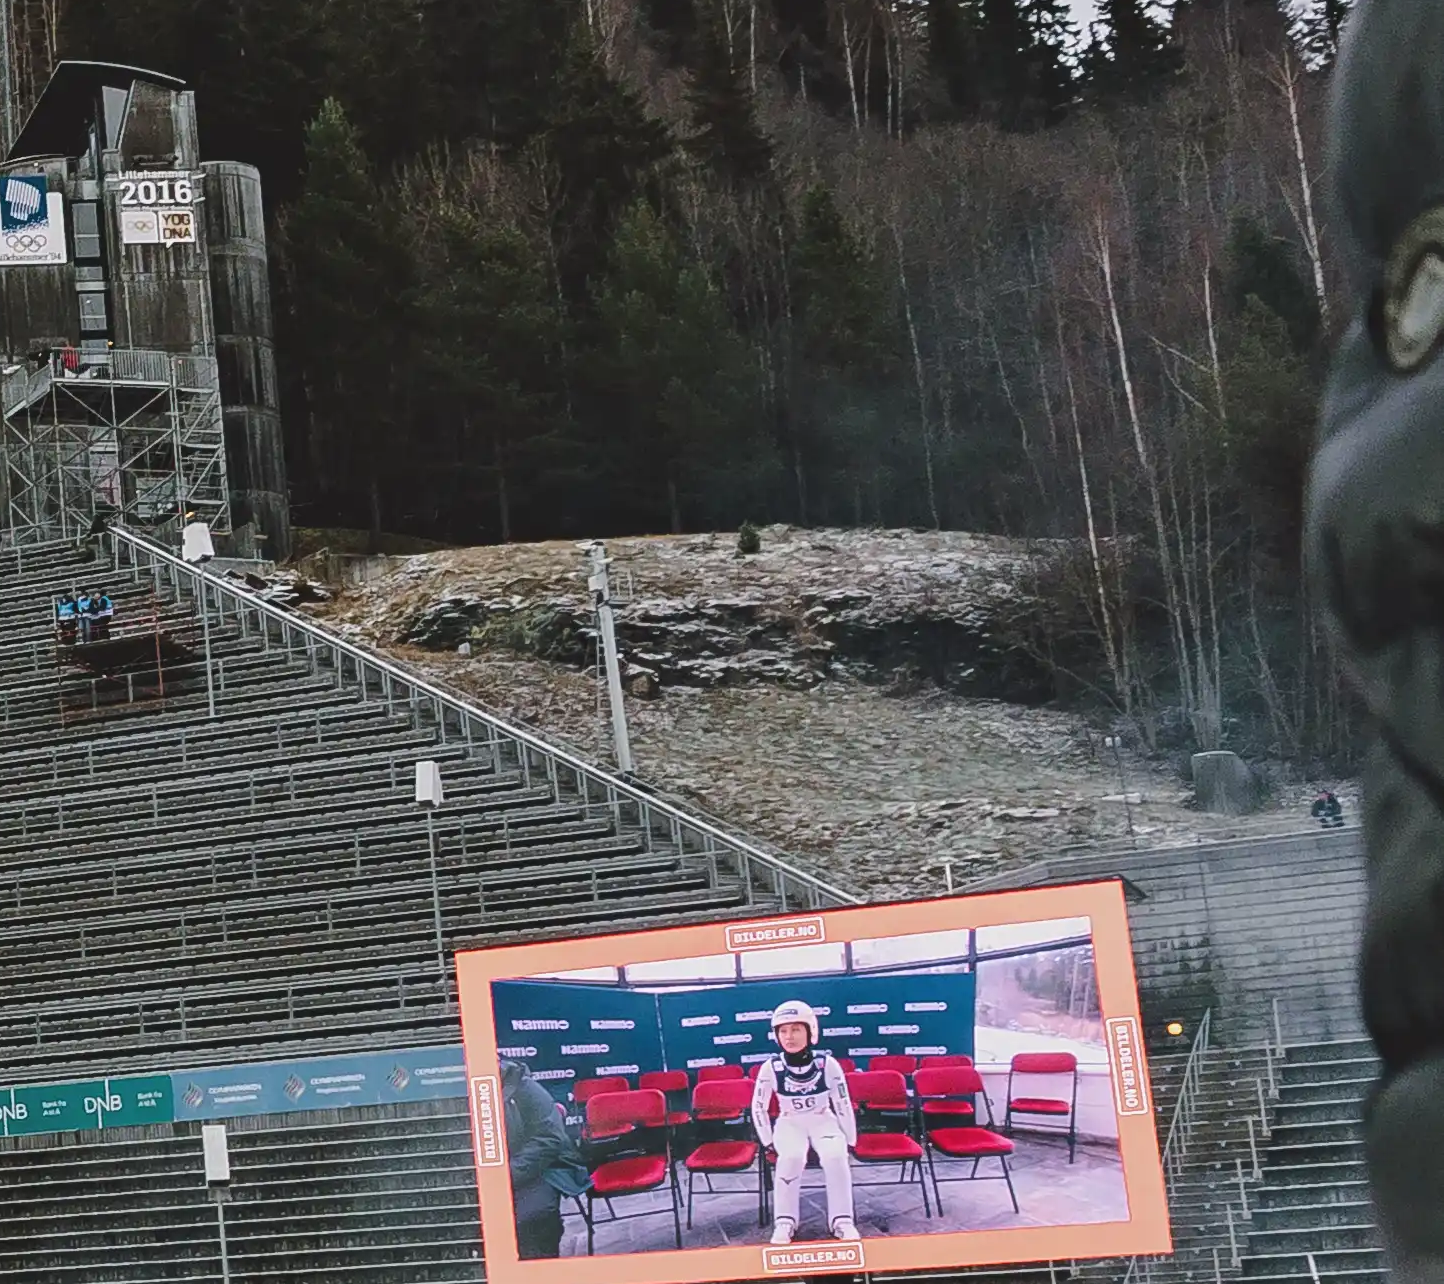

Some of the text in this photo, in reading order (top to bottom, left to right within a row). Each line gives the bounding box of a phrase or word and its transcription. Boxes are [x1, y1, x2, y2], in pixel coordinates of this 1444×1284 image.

[121, 180, 192, 205] 2016
[163, 214, 191, 225] YOG
[164, 227, 191, 240] DNA
[733, 925, 816, 944] BILDELER.NO
[497, 1046, 537, 1057] mmo
[530, 1069, 575, 1080] ammo
[84, 1087, 122, 1120] DNB
[479, 1082, 496, 1159] BILDELER.NO
[770, 1250, 855, 1266] BILDELER.NO
